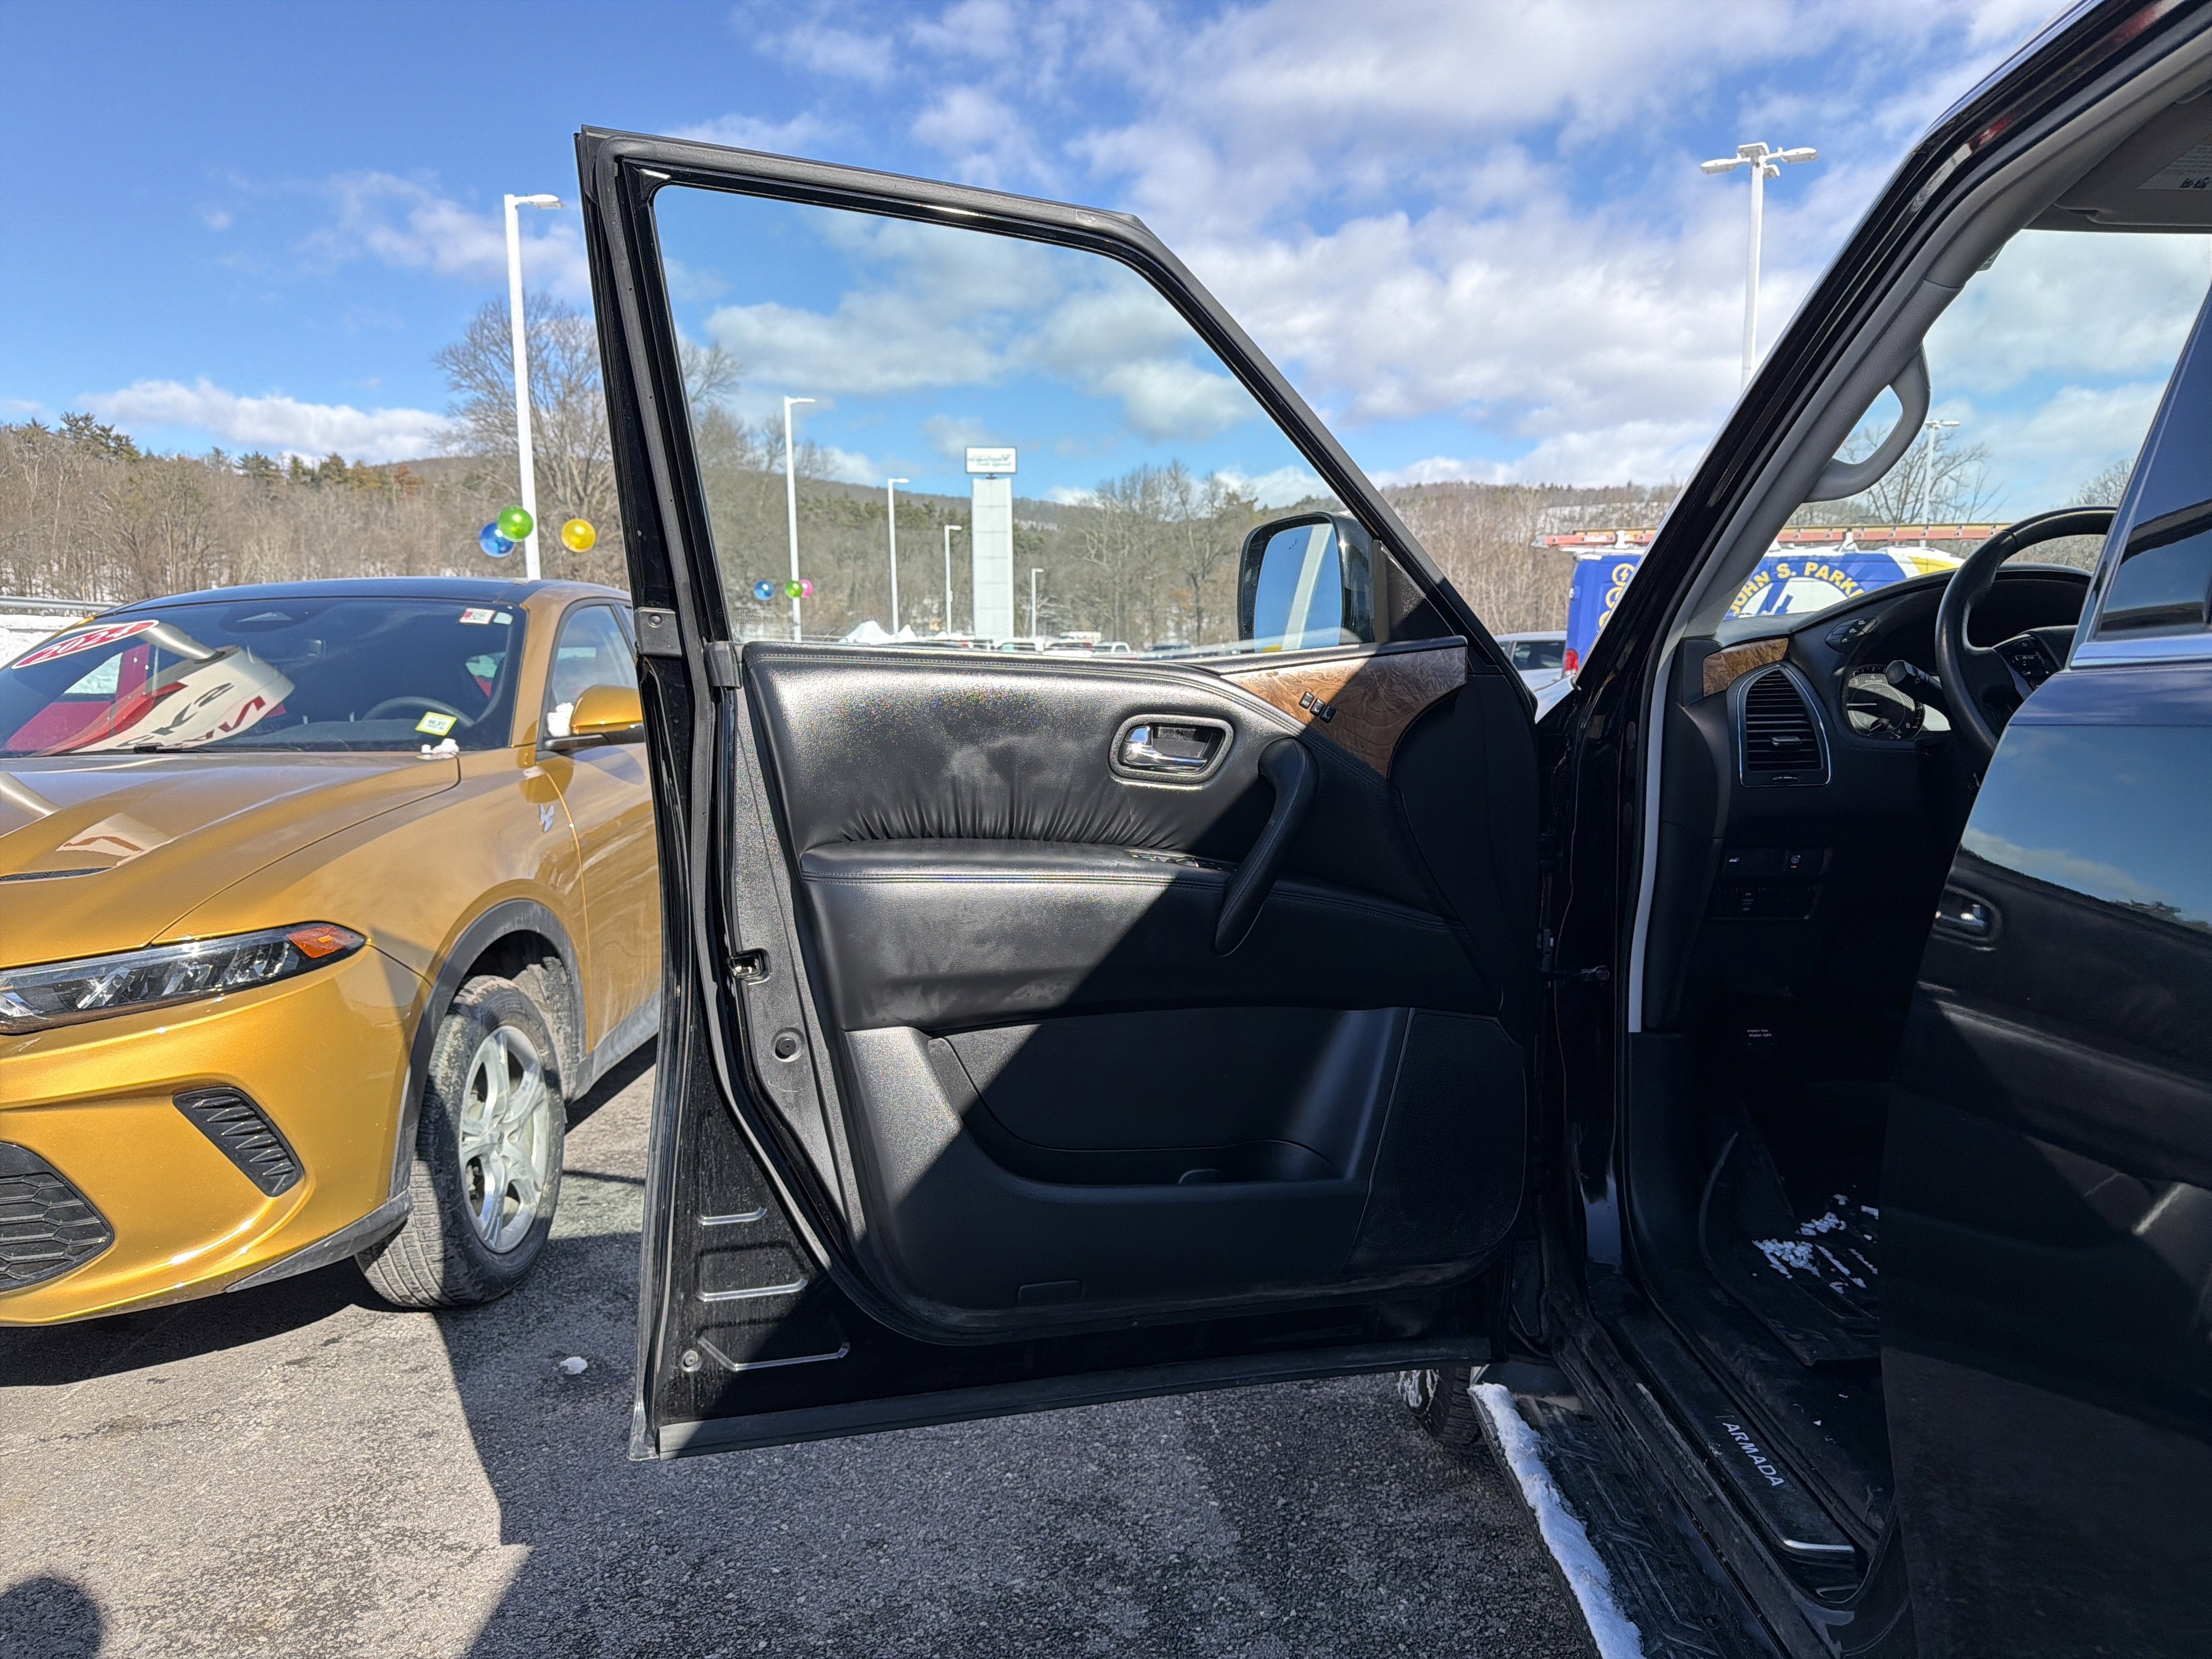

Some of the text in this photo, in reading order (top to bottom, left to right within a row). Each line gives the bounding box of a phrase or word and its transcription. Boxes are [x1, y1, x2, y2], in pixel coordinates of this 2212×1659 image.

[1730, 571, 1770, 617] JOHN
[1776, 562, 1797, 579] S.
[1722, 1423, 1785, 1486] ARMADA
